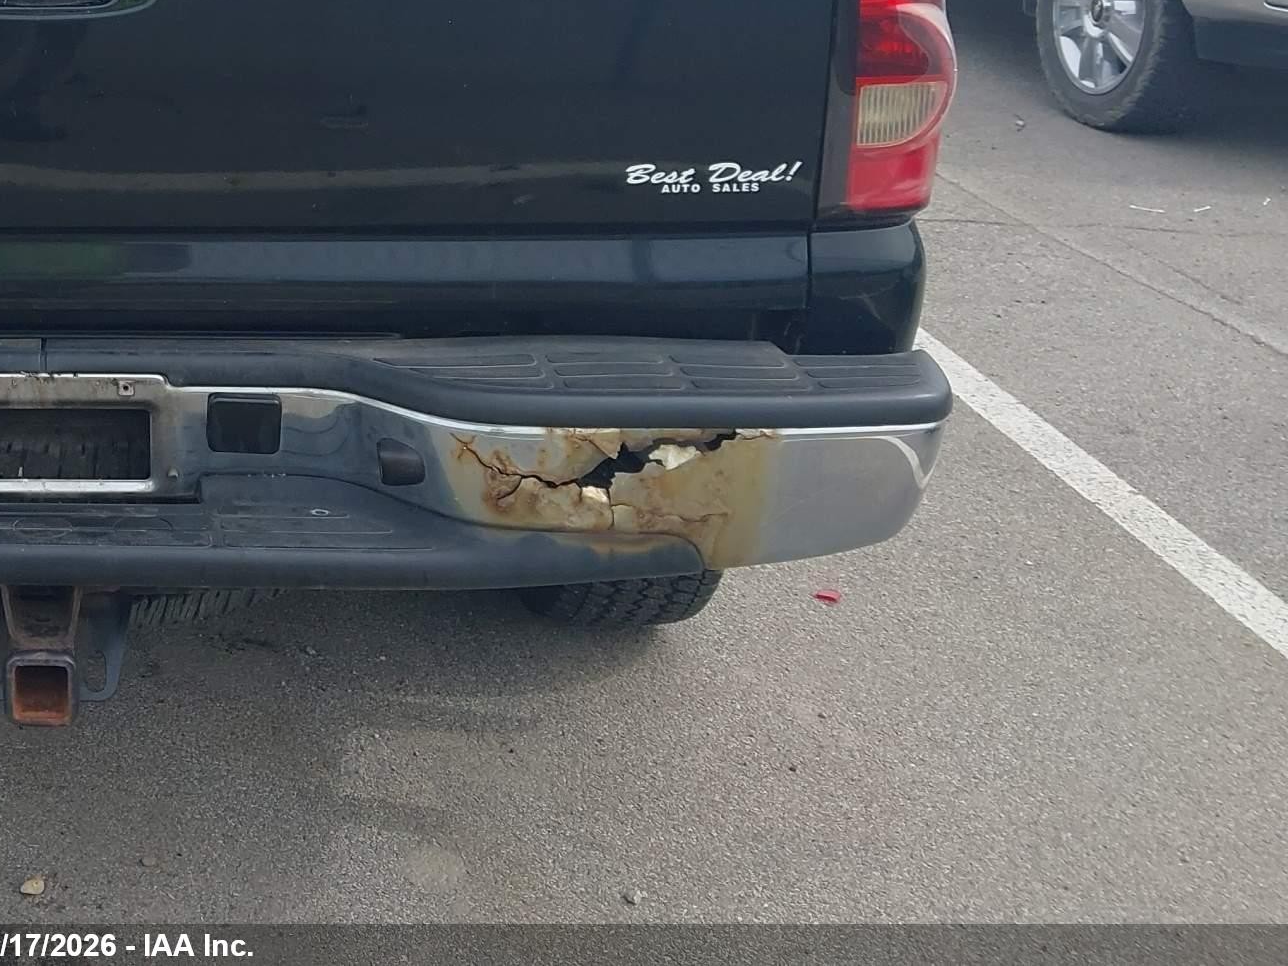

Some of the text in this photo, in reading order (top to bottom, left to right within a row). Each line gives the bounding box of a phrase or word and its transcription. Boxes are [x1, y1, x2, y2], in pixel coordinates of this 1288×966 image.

[625, 161, 803, 184] Best Deal!
[661, 182, 760, 194] AUTO SALES
